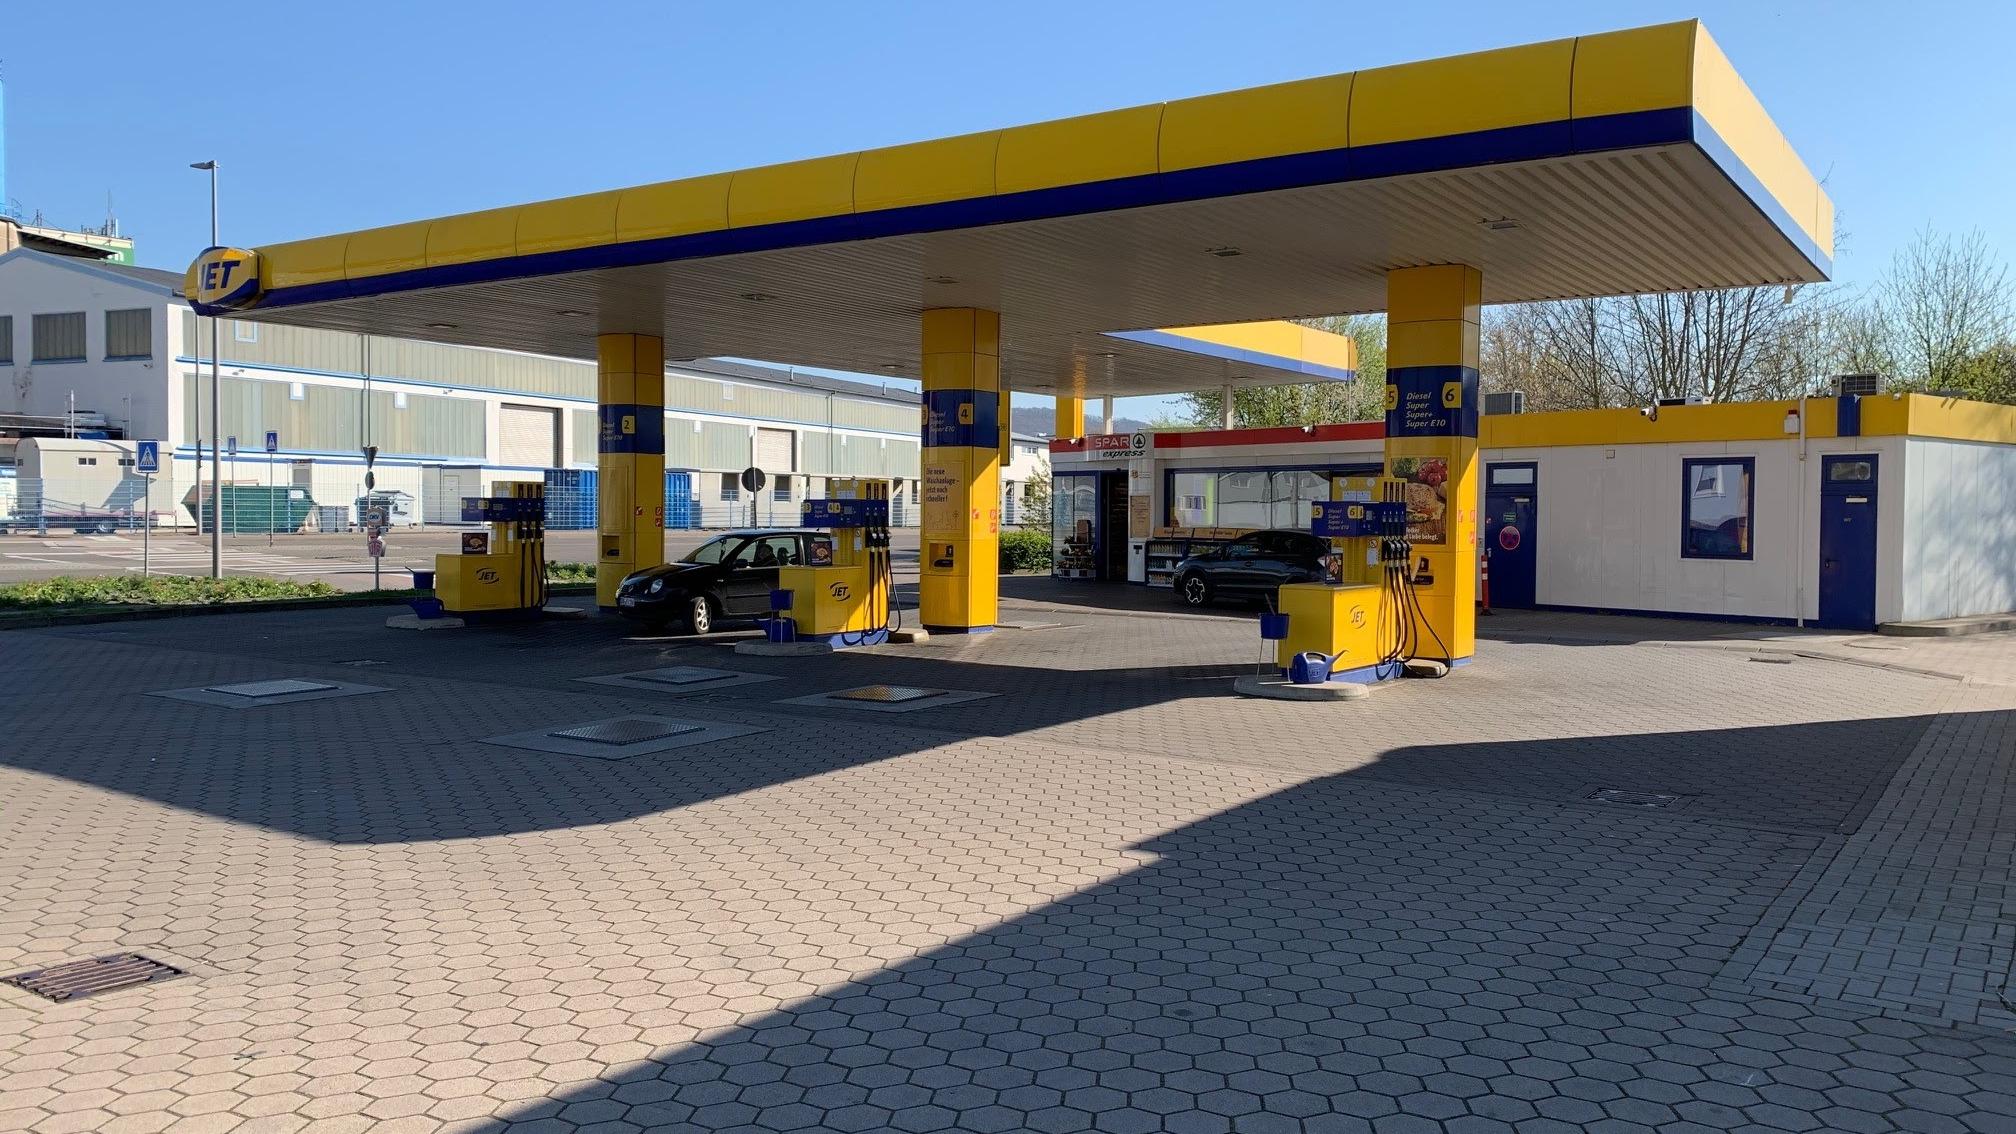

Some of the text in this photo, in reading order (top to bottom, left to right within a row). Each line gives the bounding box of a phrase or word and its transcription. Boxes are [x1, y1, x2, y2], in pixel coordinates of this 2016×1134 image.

[1388, 390, 1395, 403] 5
[1406, 392, 1432, 400] Diesel
[1445, 388, 1454, 401] 6
[1406, 402, 1430, 411] Super
[961, 409, 969, 419] 4
[1406, 411, 1433, 420] Super+
[624, 420, 630, 430] 2
[1406, 420, 1429, 429] Super
[1095, 437, 1130, 448] SPAR
[1103, 450, 1146, 459] express
[1316, 508, 1321, 516] 5
[479, 571, 497, 580] JET
[832, 587, 848, 597] JET
[1352, 611, 1364, 623] JET
